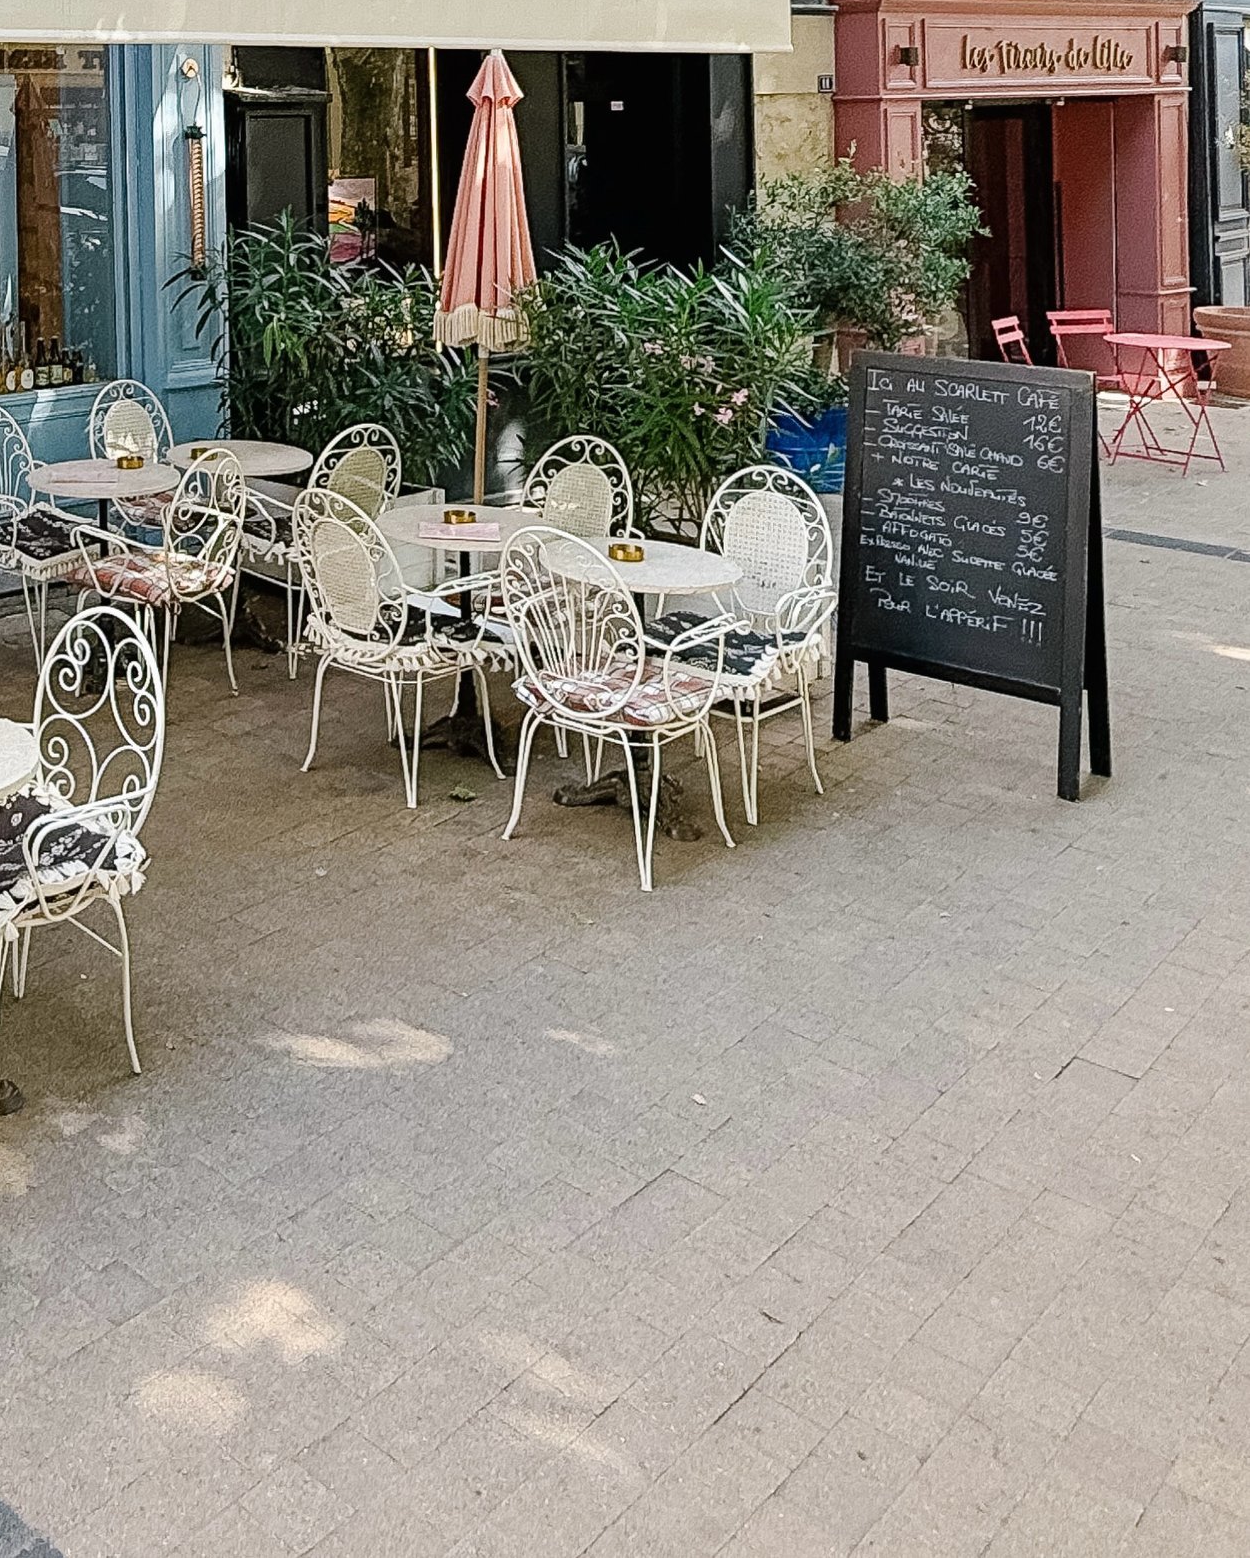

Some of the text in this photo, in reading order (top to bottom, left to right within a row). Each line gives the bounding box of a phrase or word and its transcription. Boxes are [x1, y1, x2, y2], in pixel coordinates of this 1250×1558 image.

[1064, 38, 1090, 70] de
[906, 378, 925, 393] AU
[934, 379, 1010, 405] SCARLETT
[882, 417, 1064, 454] SUGGESTION 16€
[1022, 414, 1062, 433] 12€
[891, 449, 940, 471] NOTRE
[952, 461, 1000, 481] CARTE
[1037, 454, 1066, 474] 6€
[910, 473, 935, 491] LES
[1016, 511, 1049, 529] 9€
[882, 521, 1045, 563] AFFOGATO 5€
[1020, 529, 1050, 547] 5€
[951, 549, 1006, 571] SUCETTE
[865, 564, 886, 583] ET
[899, 571, 916, 587] LE
[988, 585, 1047, 617] VENEZ
[870, 587, 912, 614] POUR
